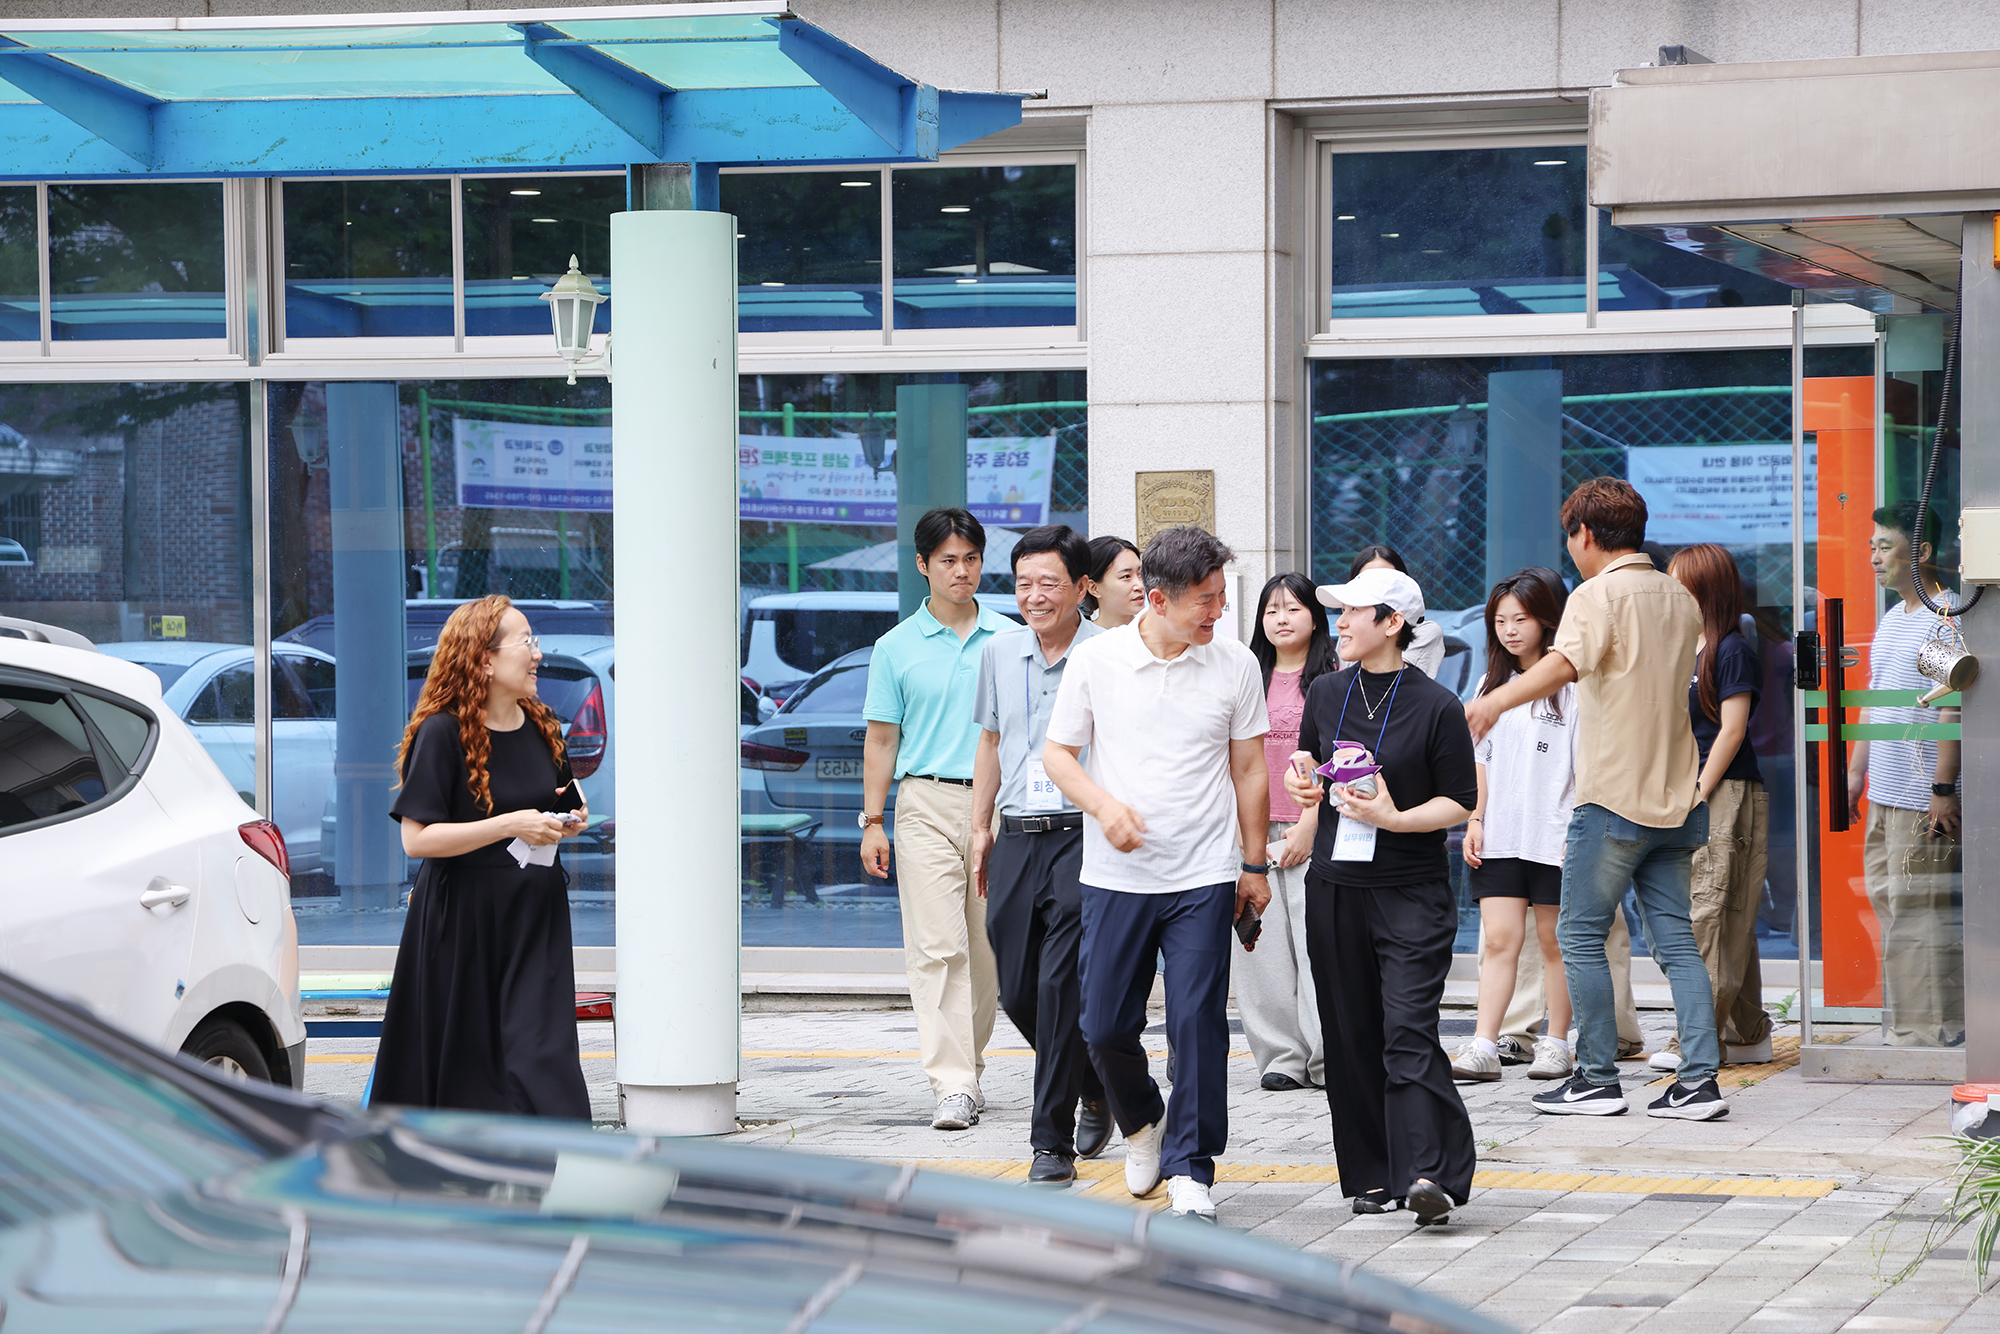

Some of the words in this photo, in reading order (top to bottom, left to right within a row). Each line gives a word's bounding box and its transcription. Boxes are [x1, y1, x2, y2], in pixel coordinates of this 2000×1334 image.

[1536, 740, 1549, 753] 89
[1033, 780, 1055, 793] 회장
[1343, 832, 1374, 843] 실무위원
